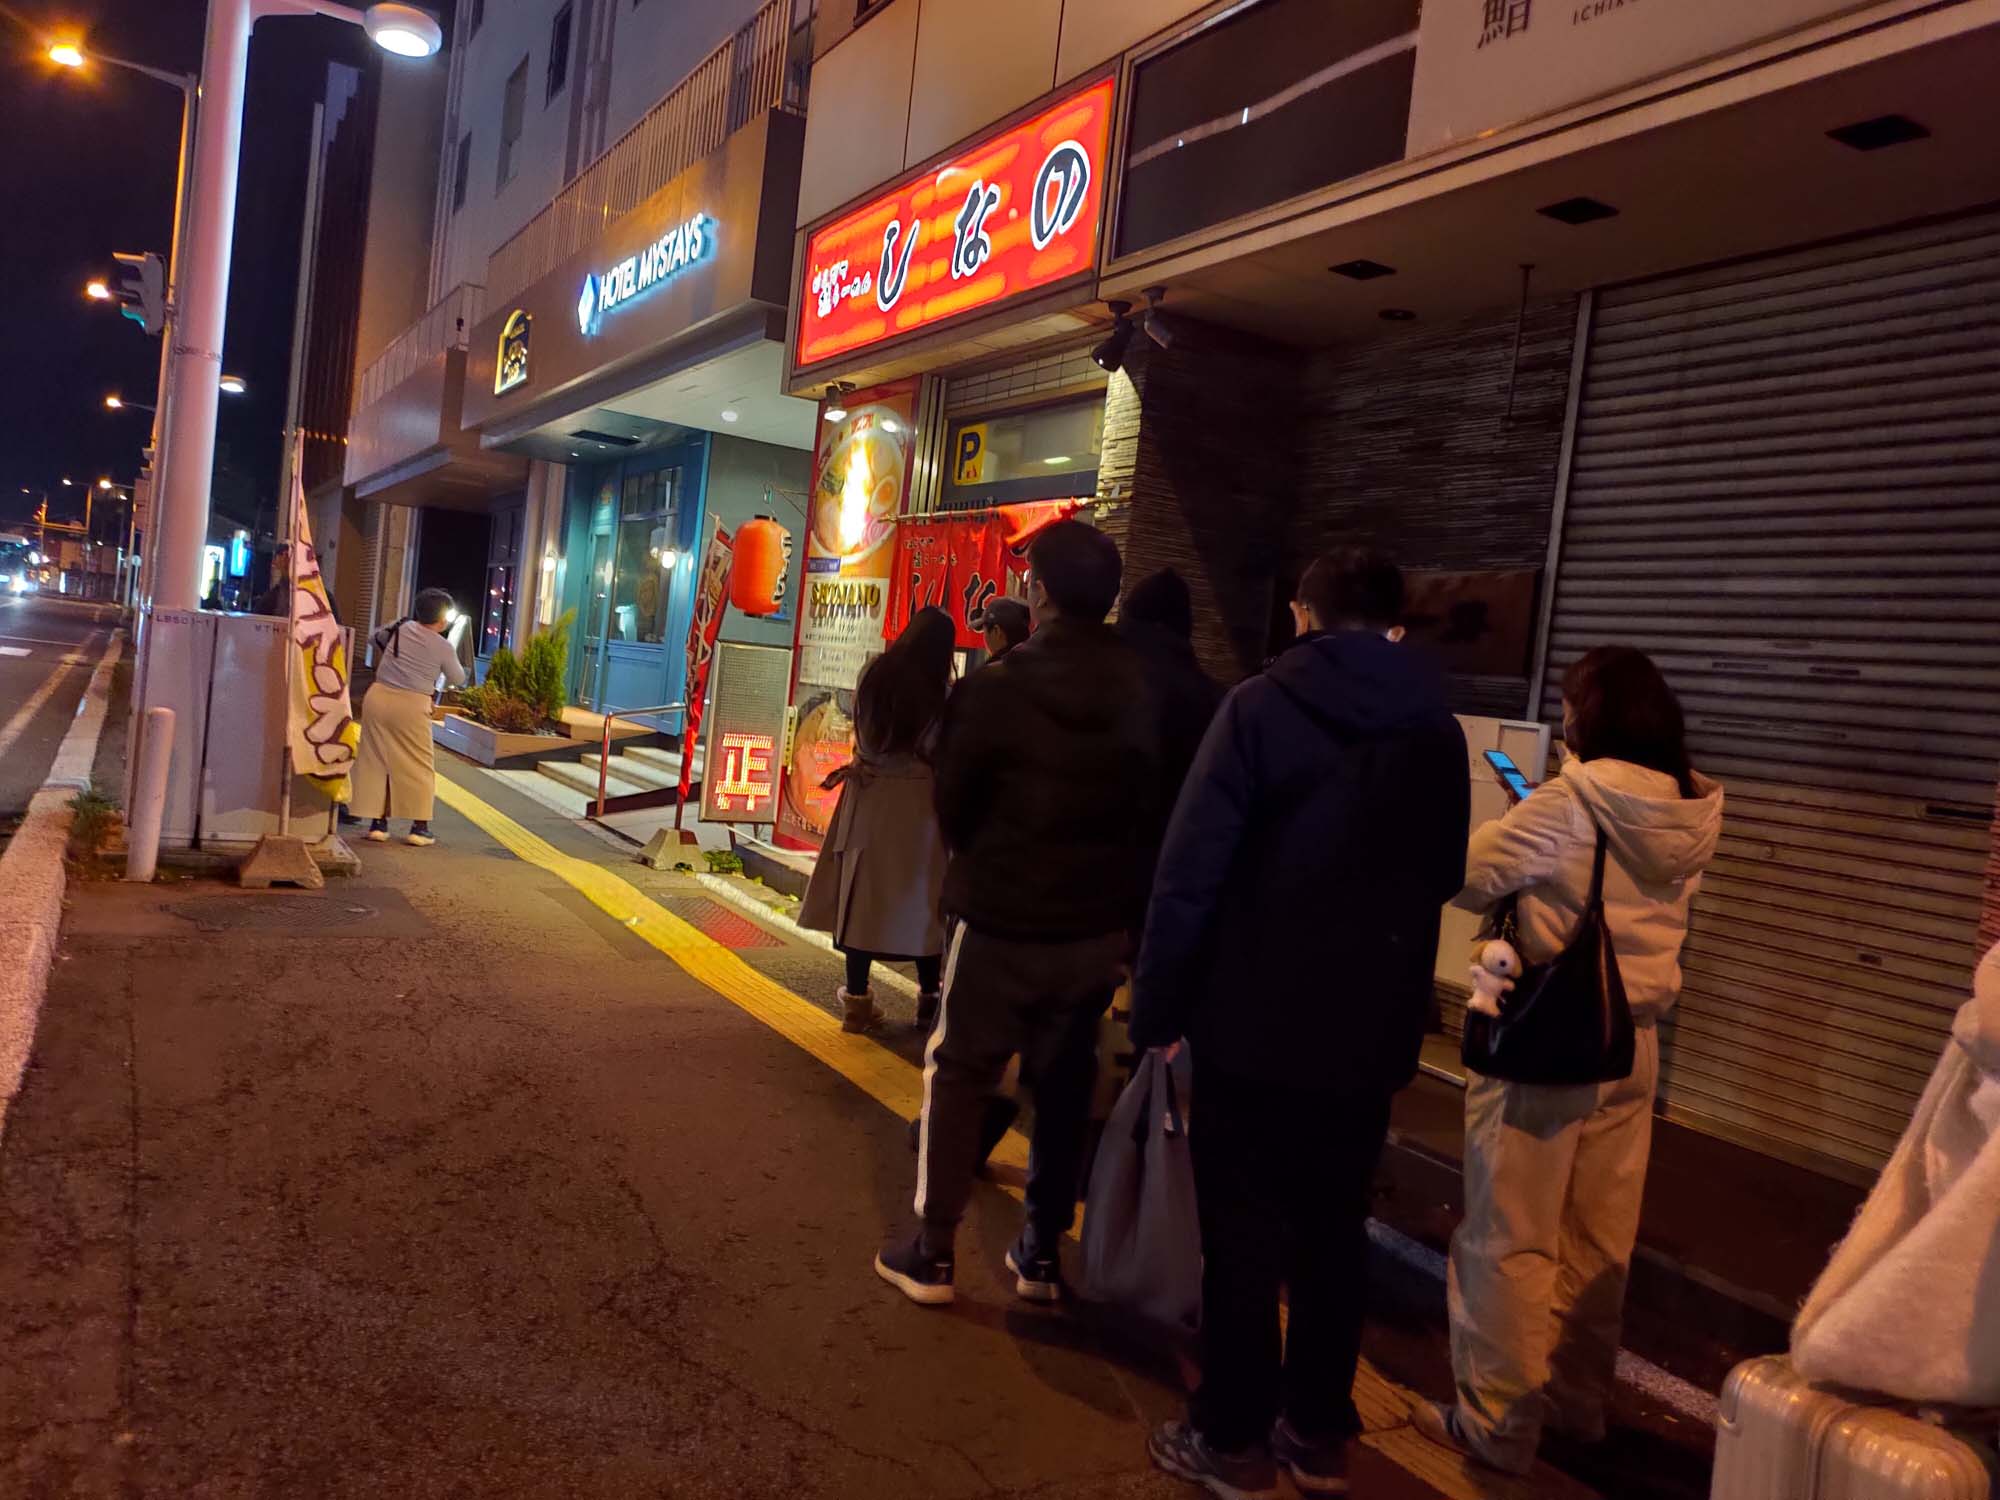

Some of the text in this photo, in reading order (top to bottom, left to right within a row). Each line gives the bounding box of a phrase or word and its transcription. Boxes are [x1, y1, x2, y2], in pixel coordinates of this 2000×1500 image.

[598, 212, 704, 313] HOTEL MYSTAYS
[958, 431, 980, 480] P
[715, 733, 773, 811] 正
